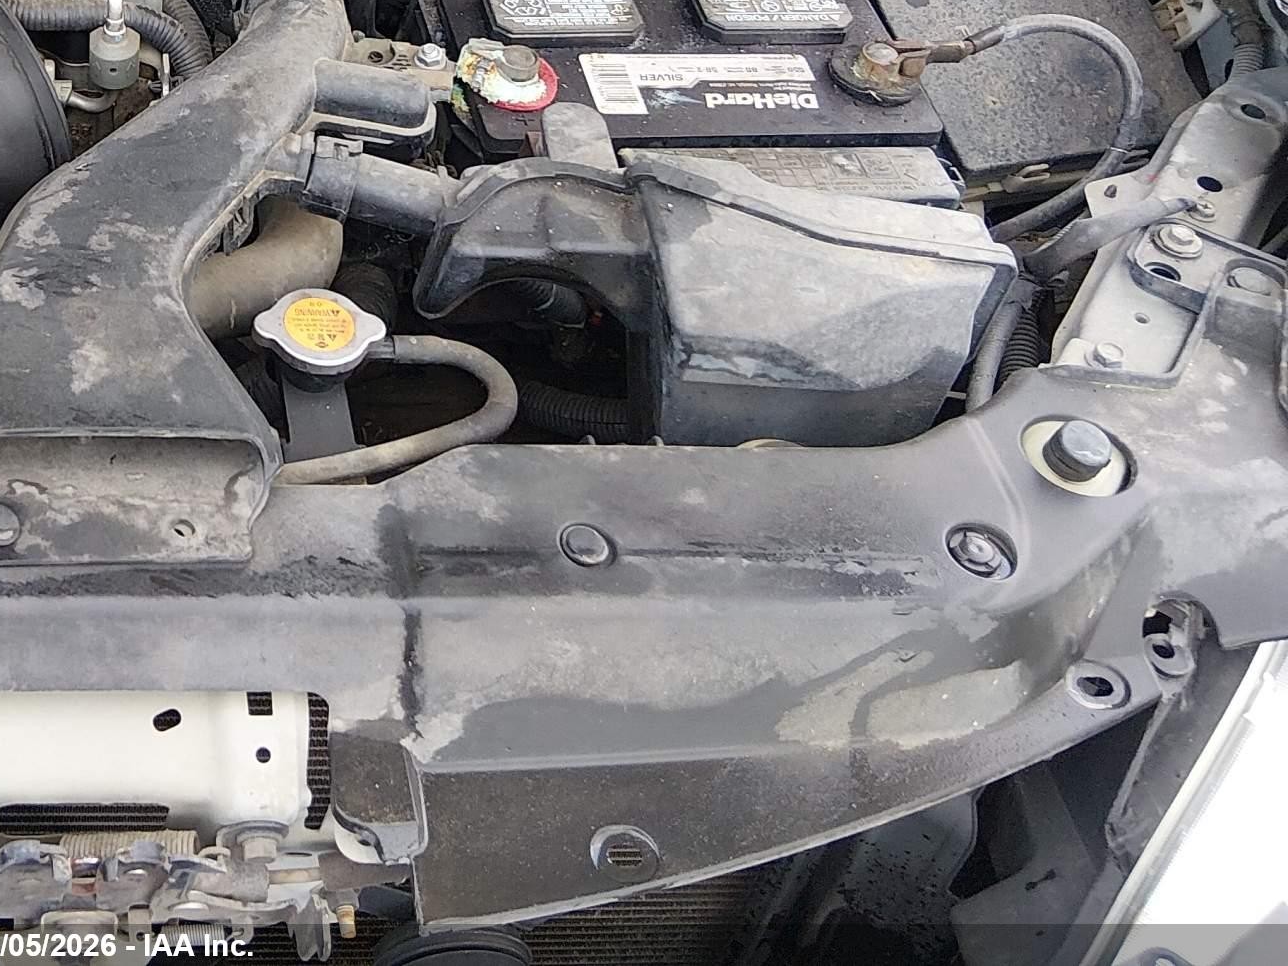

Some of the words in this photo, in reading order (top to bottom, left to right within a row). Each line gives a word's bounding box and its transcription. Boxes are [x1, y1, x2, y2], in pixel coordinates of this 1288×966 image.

[725, 13, 771, 22] POISON
[780, 13, 830, 22] DANGER
[639, 73, 684, 82] SILVER
[703, 91, 820, 110] DieHard
